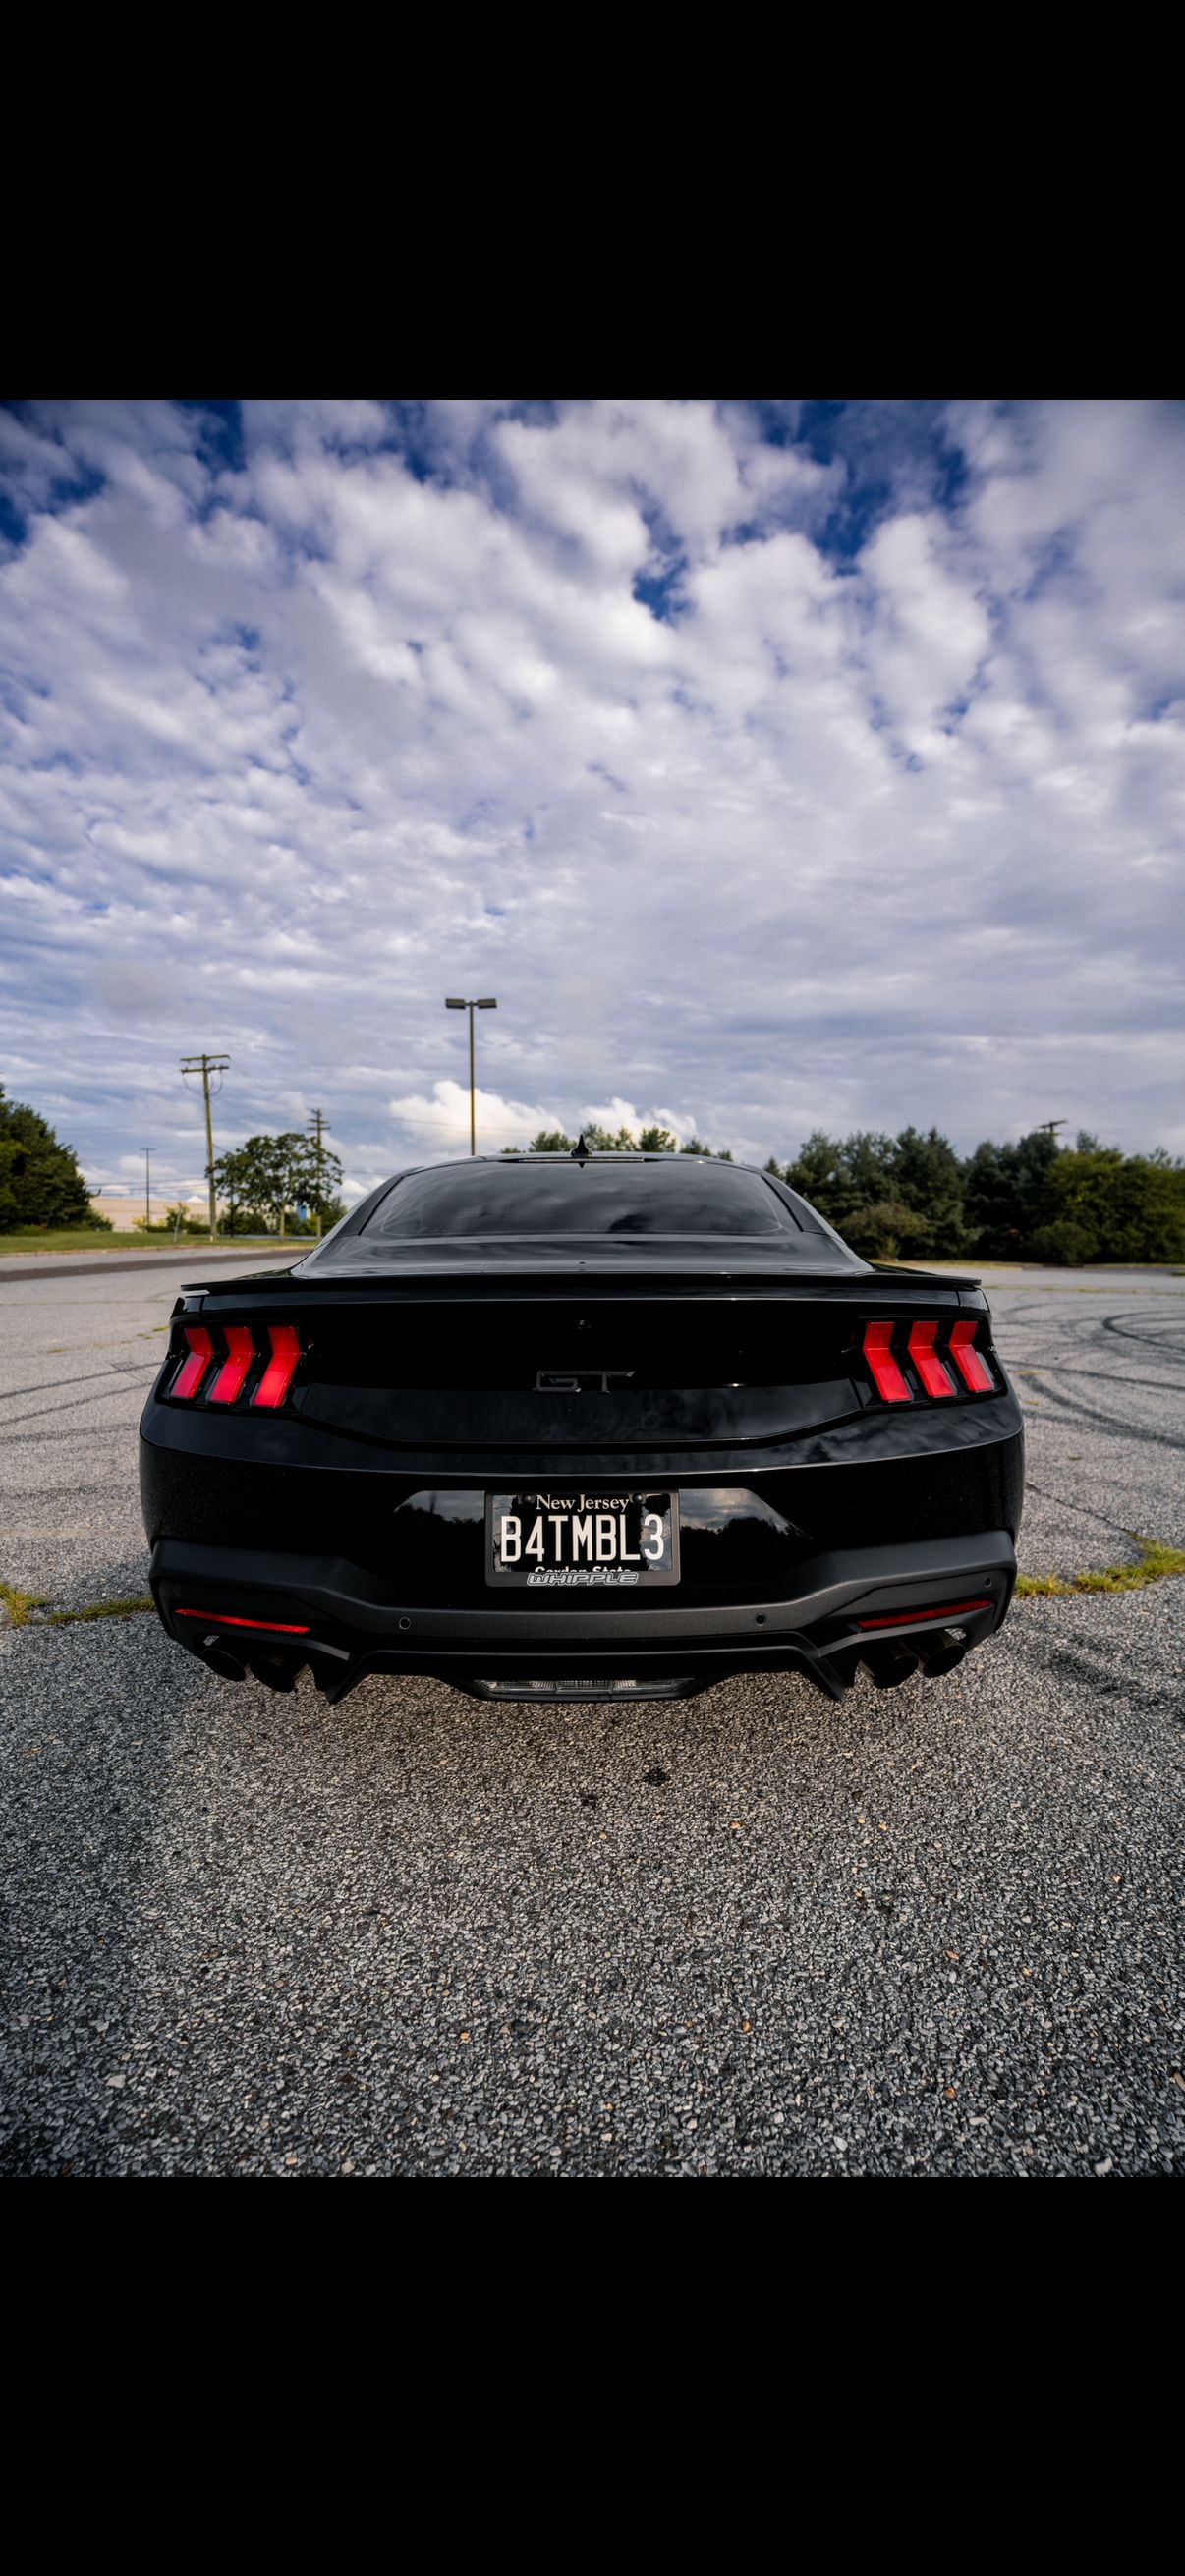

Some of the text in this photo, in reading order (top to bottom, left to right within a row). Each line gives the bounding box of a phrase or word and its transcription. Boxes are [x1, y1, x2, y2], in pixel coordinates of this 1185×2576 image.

[533, 1370, 636, 1394] GT
[536, 1494, 630, 1513] New Jersey
[500, 1513, 665, 1563] B4TMBL3
[527, 1572, 639, 1587] WHIPPLE
